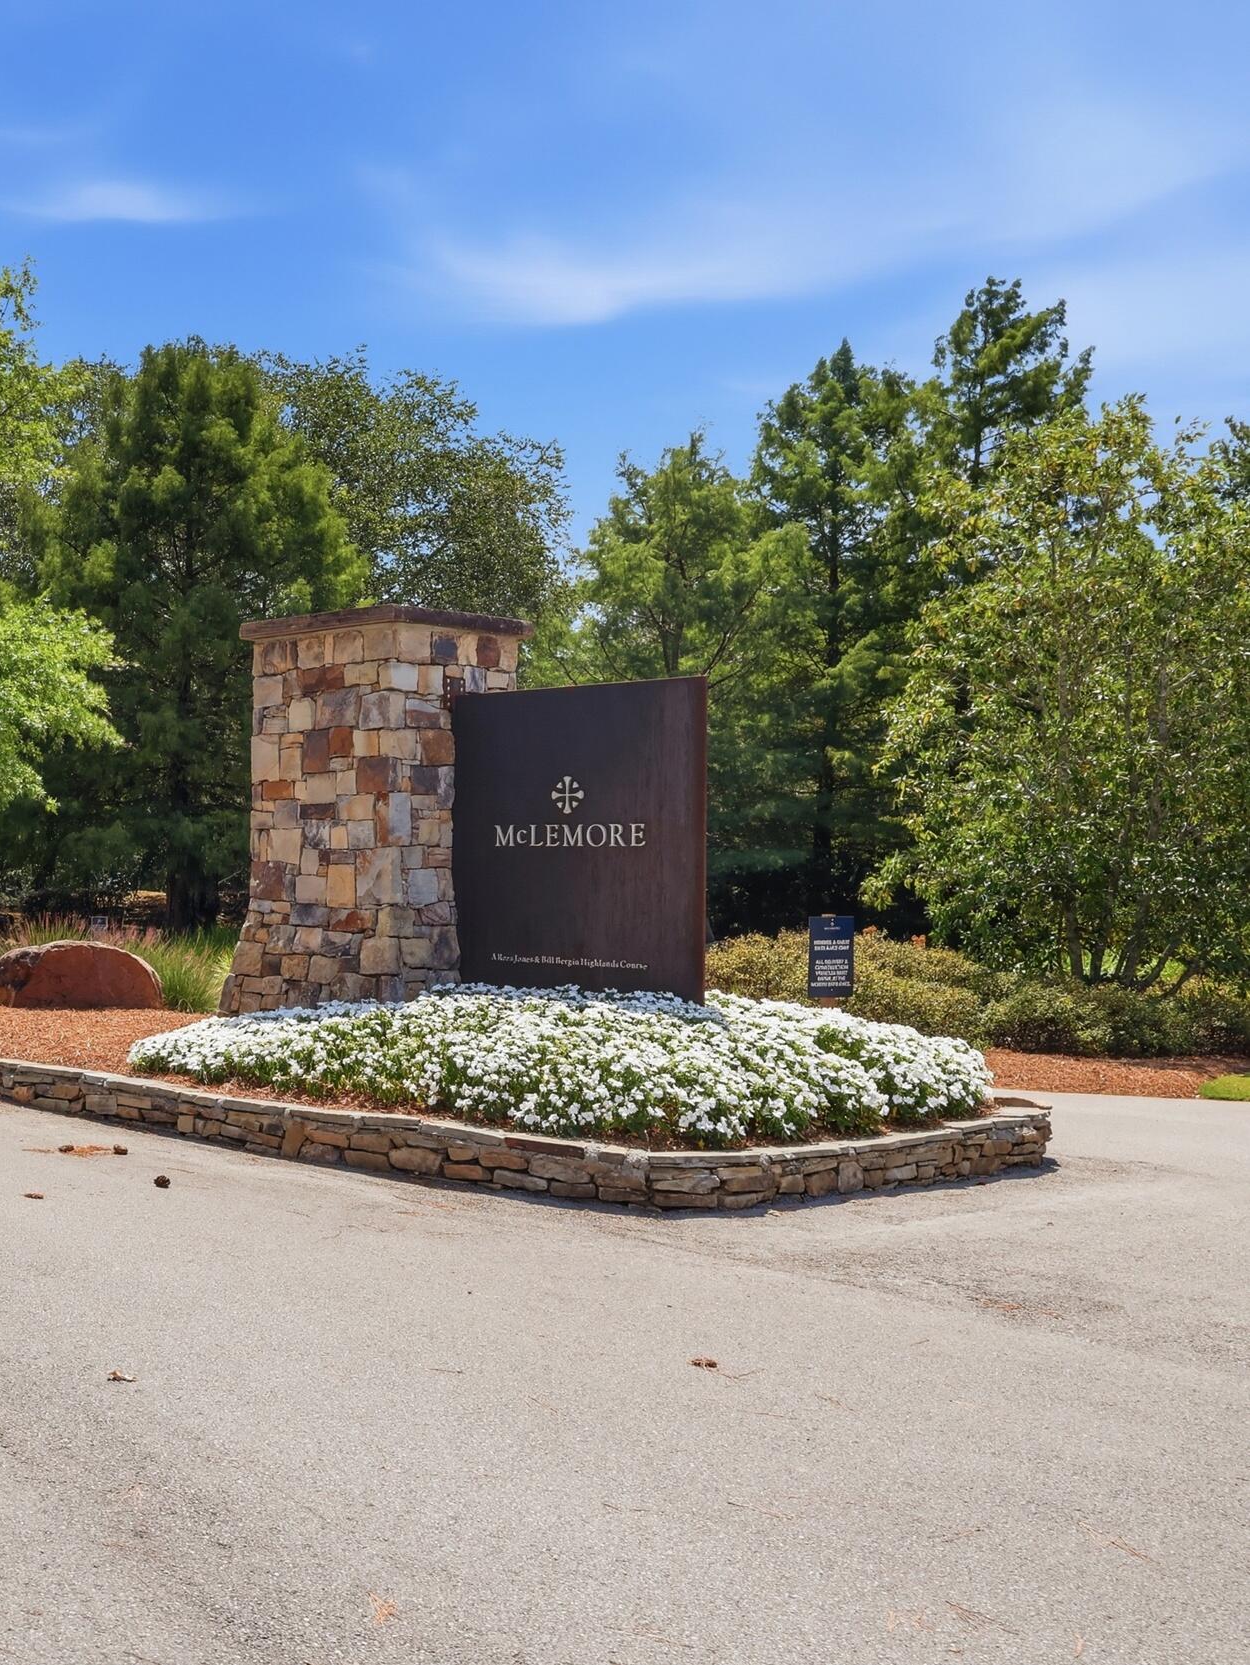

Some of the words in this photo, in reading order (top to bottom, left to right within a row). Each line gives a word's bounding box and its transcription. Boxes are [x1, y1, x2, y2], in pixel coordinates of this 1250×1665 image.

[494, 823, 647, 848] McLEMORE
[513, 954, 535, 964] Jones
[534, 956, 541, 964] &
[541, 956, 555, 965] Bill
[580, 958, 619, 969] Highlands
[619, 960, 648, 970] Course
